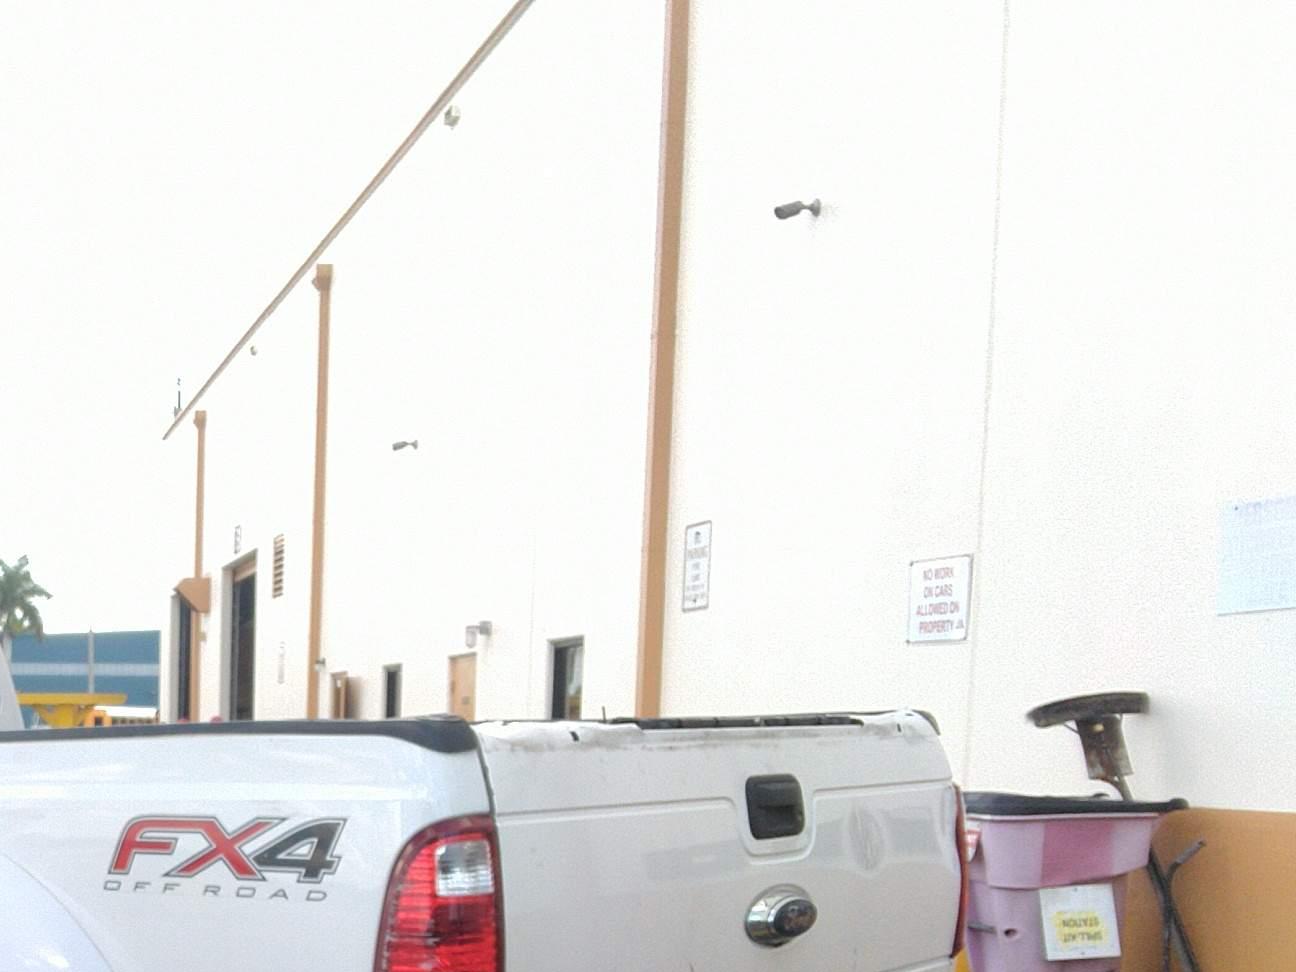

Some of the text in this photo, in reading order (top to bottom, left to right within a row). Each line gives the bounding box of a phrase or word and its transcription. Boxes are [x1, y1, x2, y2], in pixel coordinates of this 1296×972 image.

[923, 567, 954, 580] NO WORK
[923, 584, 953, 598] ON CARS
[916, 601, 960, 616] ALLOWED ON
[919, 620, 954, 633] PROPERTY
[108, 815, 348, 884] FX4
